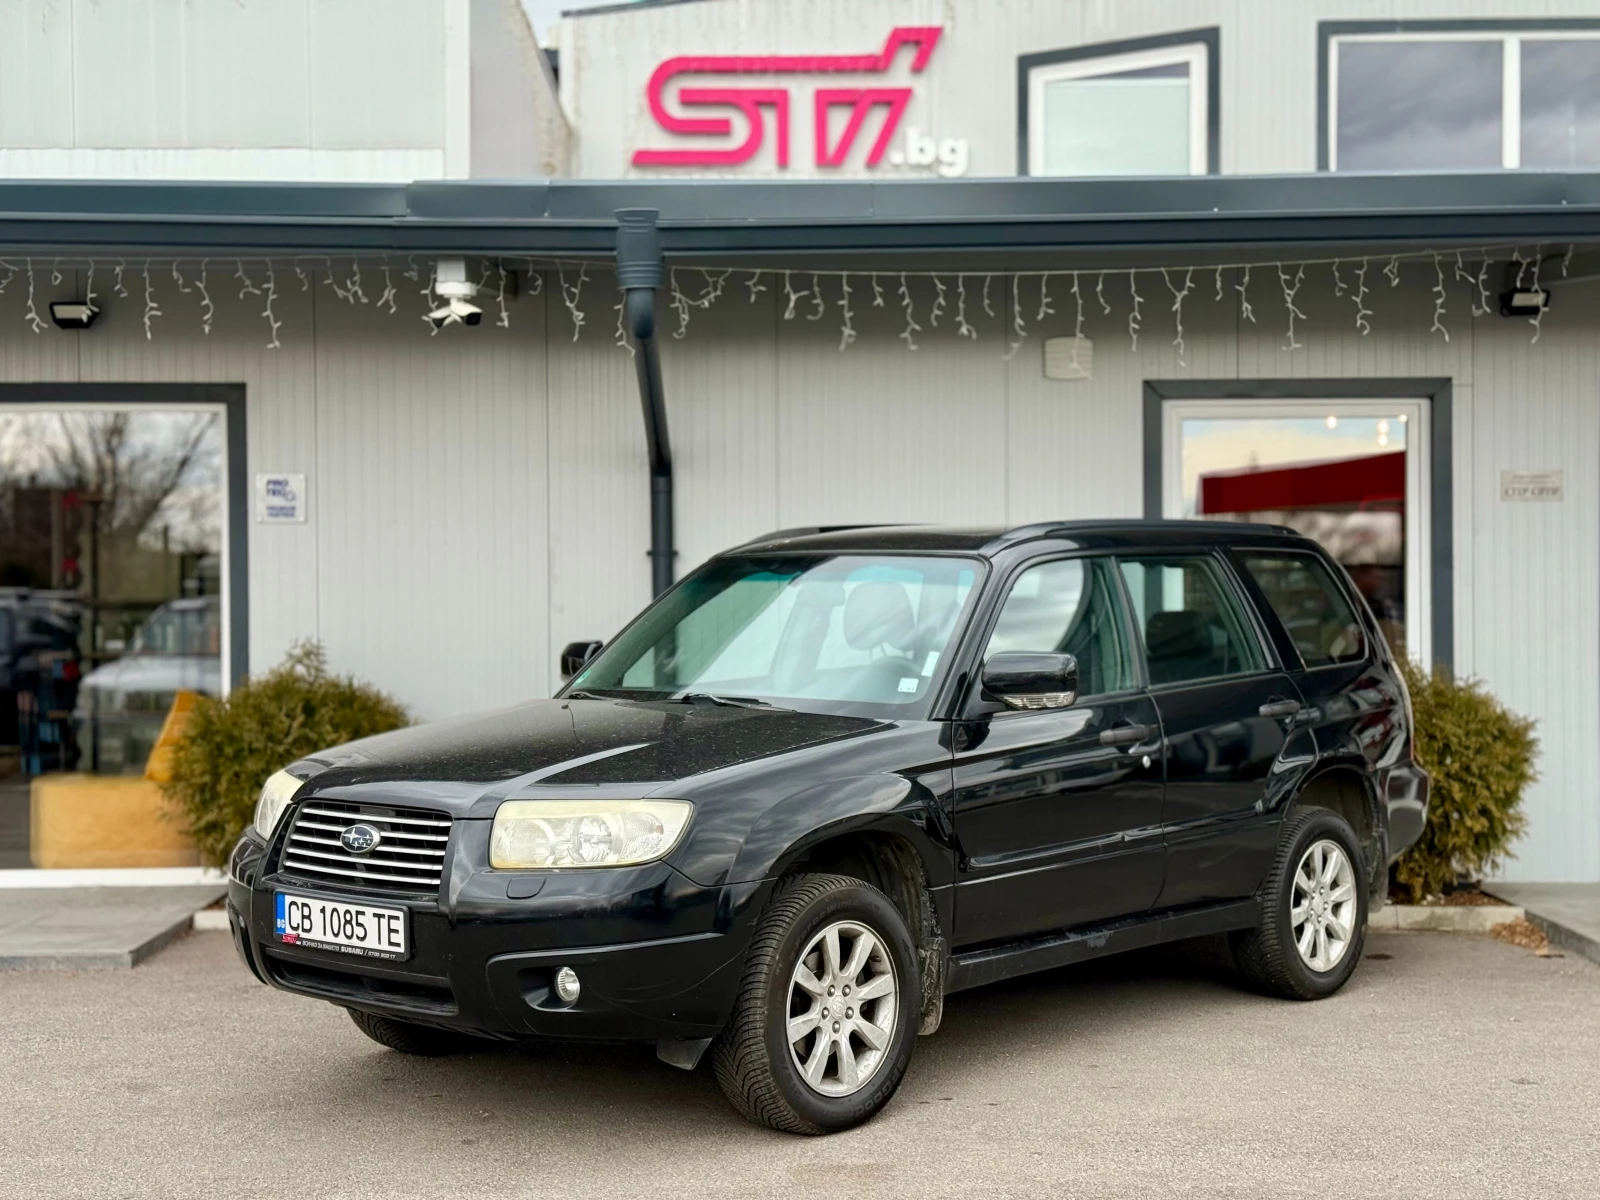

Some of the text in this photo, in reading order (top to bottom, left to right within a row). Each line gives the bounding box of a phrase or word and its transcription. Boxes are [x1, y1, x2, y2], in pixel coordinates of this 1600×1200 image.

[288, 900, 402, 948] CB 1085 TE
